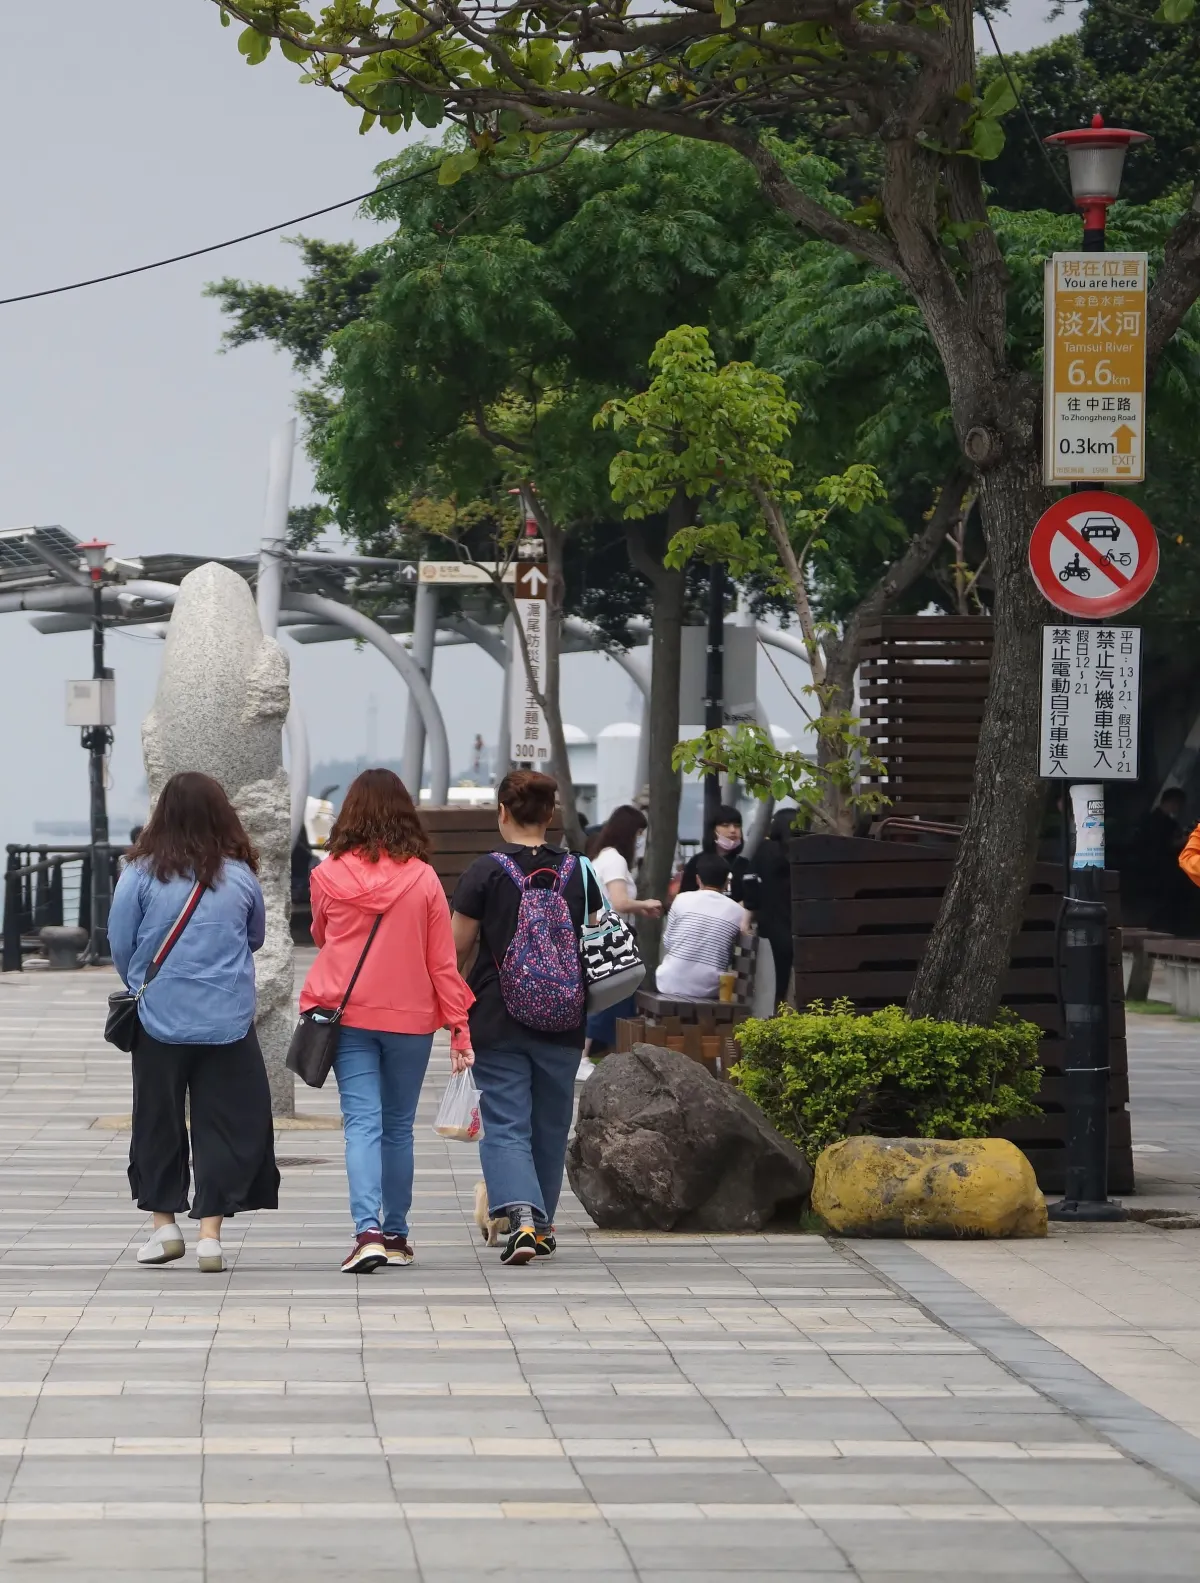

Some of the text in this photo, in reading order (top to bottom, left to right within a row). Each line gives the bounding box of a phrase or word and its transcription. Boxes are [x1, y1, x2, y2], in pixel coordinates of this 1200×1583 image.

[1062, 260, 1140, 277] 現在位置
[1064, 277, 1138, 288] You are here
[1057, 310, 1142, 337] 淡水河
[1064, 341, 1134, 353] Tamsui River
[1071, 414, 1117, 423] Zhongzheng
[1059, 437, 1115, 454] 0.3km
[1112, 455, 1137, 466] EXIT
[1049, 628, 1071, 775] 禁止電動自行車進入
[1094, 630, 1116, 769] 禁止汽機車進入
[515, 744, 547, 758] 300 m
